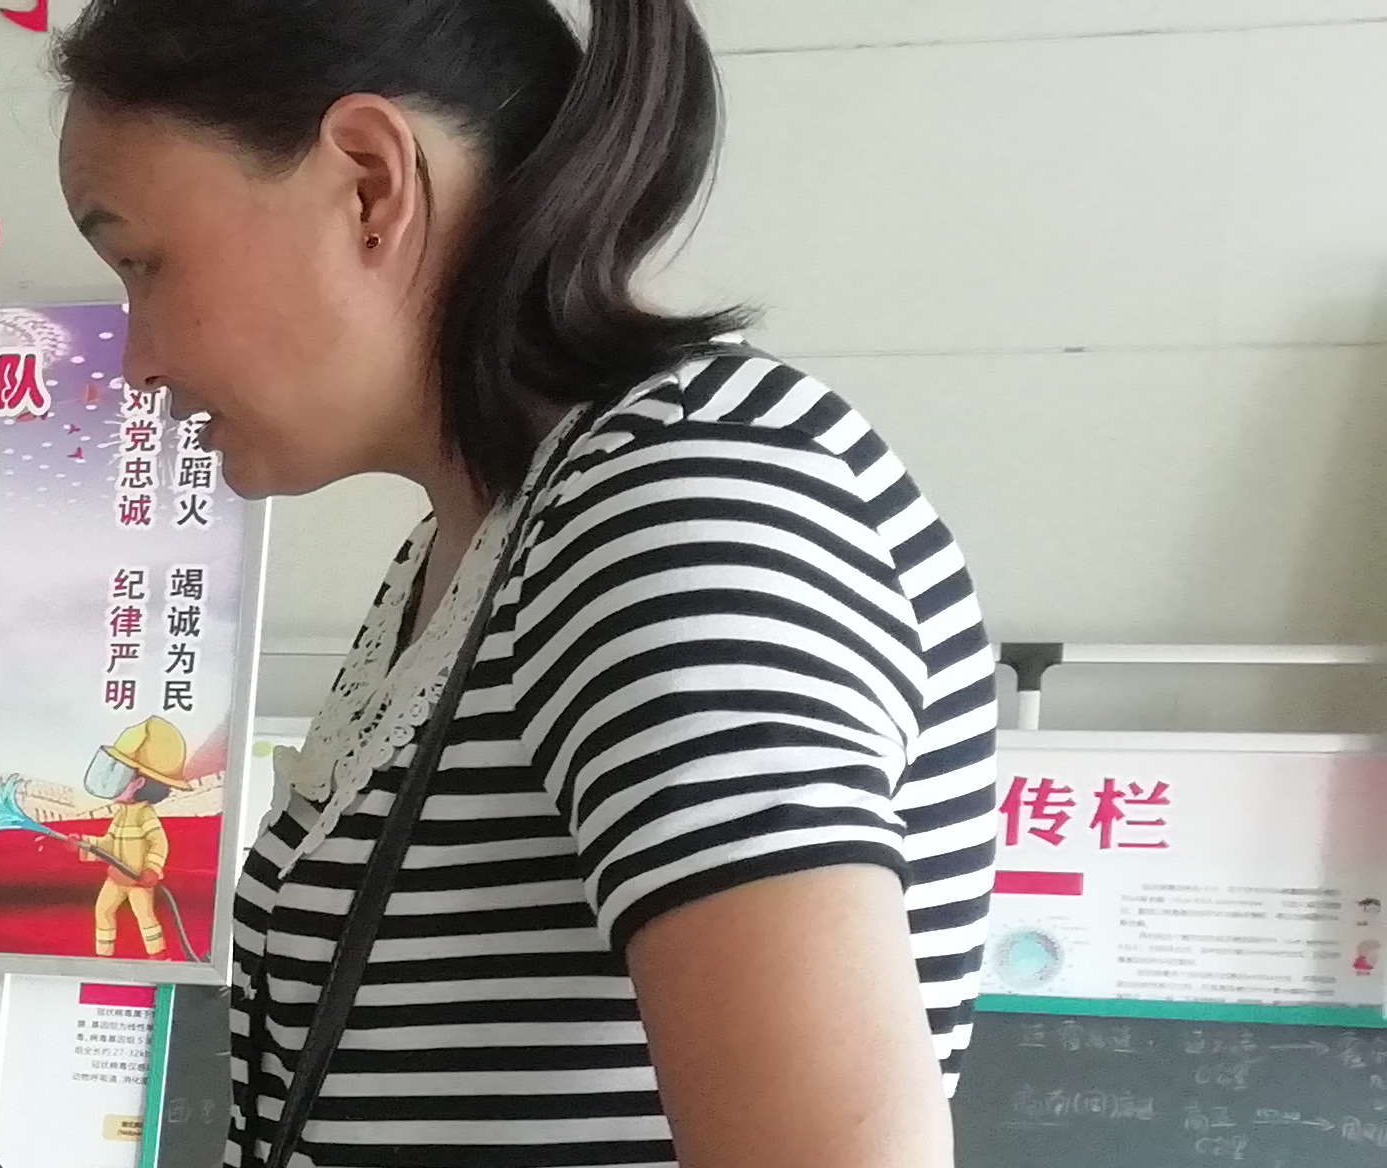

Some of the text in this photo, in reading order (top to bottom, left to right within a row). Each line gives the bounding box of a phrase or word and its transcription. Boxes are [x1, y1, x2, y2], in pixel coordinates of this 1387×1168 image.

[104, 388, 162, 710] 对党忠诚 纪律严明
[162, 567, 204, 713] 竭诚为民
[998, 776, 1172, 849] 传栏
